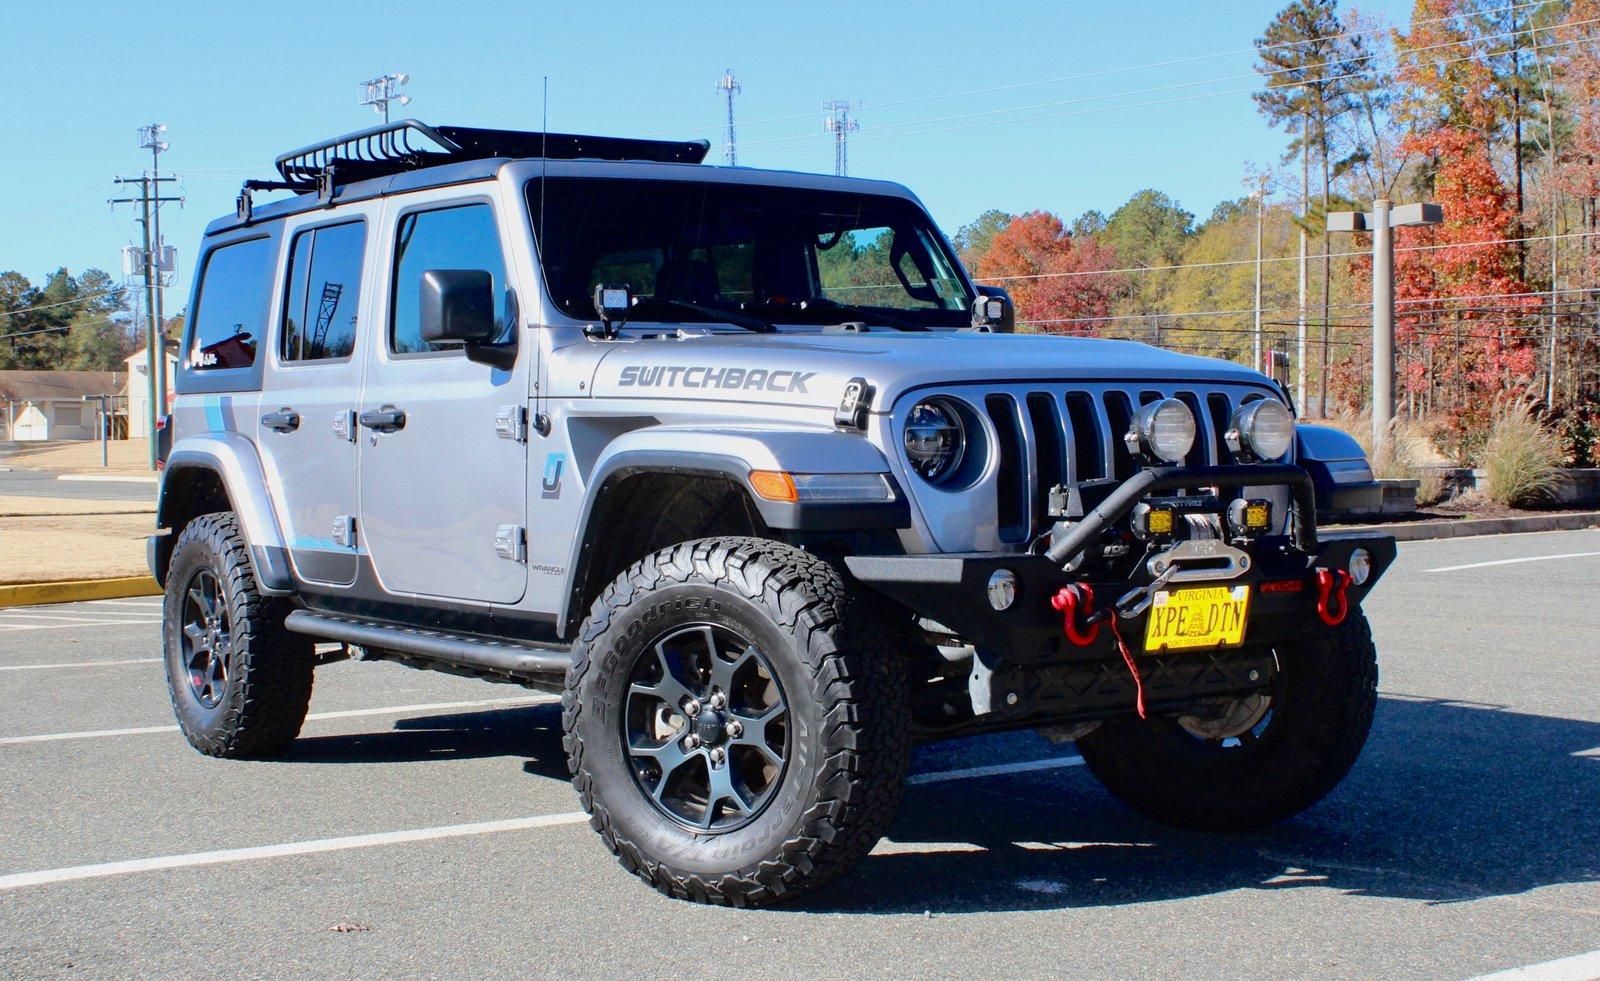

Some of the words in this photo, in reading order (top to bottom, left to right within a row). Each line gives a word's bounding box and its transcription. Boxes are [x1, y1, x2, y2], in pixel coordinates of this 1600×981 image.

[618, 366, 818, 394] SWITCHBACK
[1178, 588, 1224, 601] VIRGINIA
[1152, 604, 1188, 638] XPE
[1206, 601, 1243, 633] DTN
